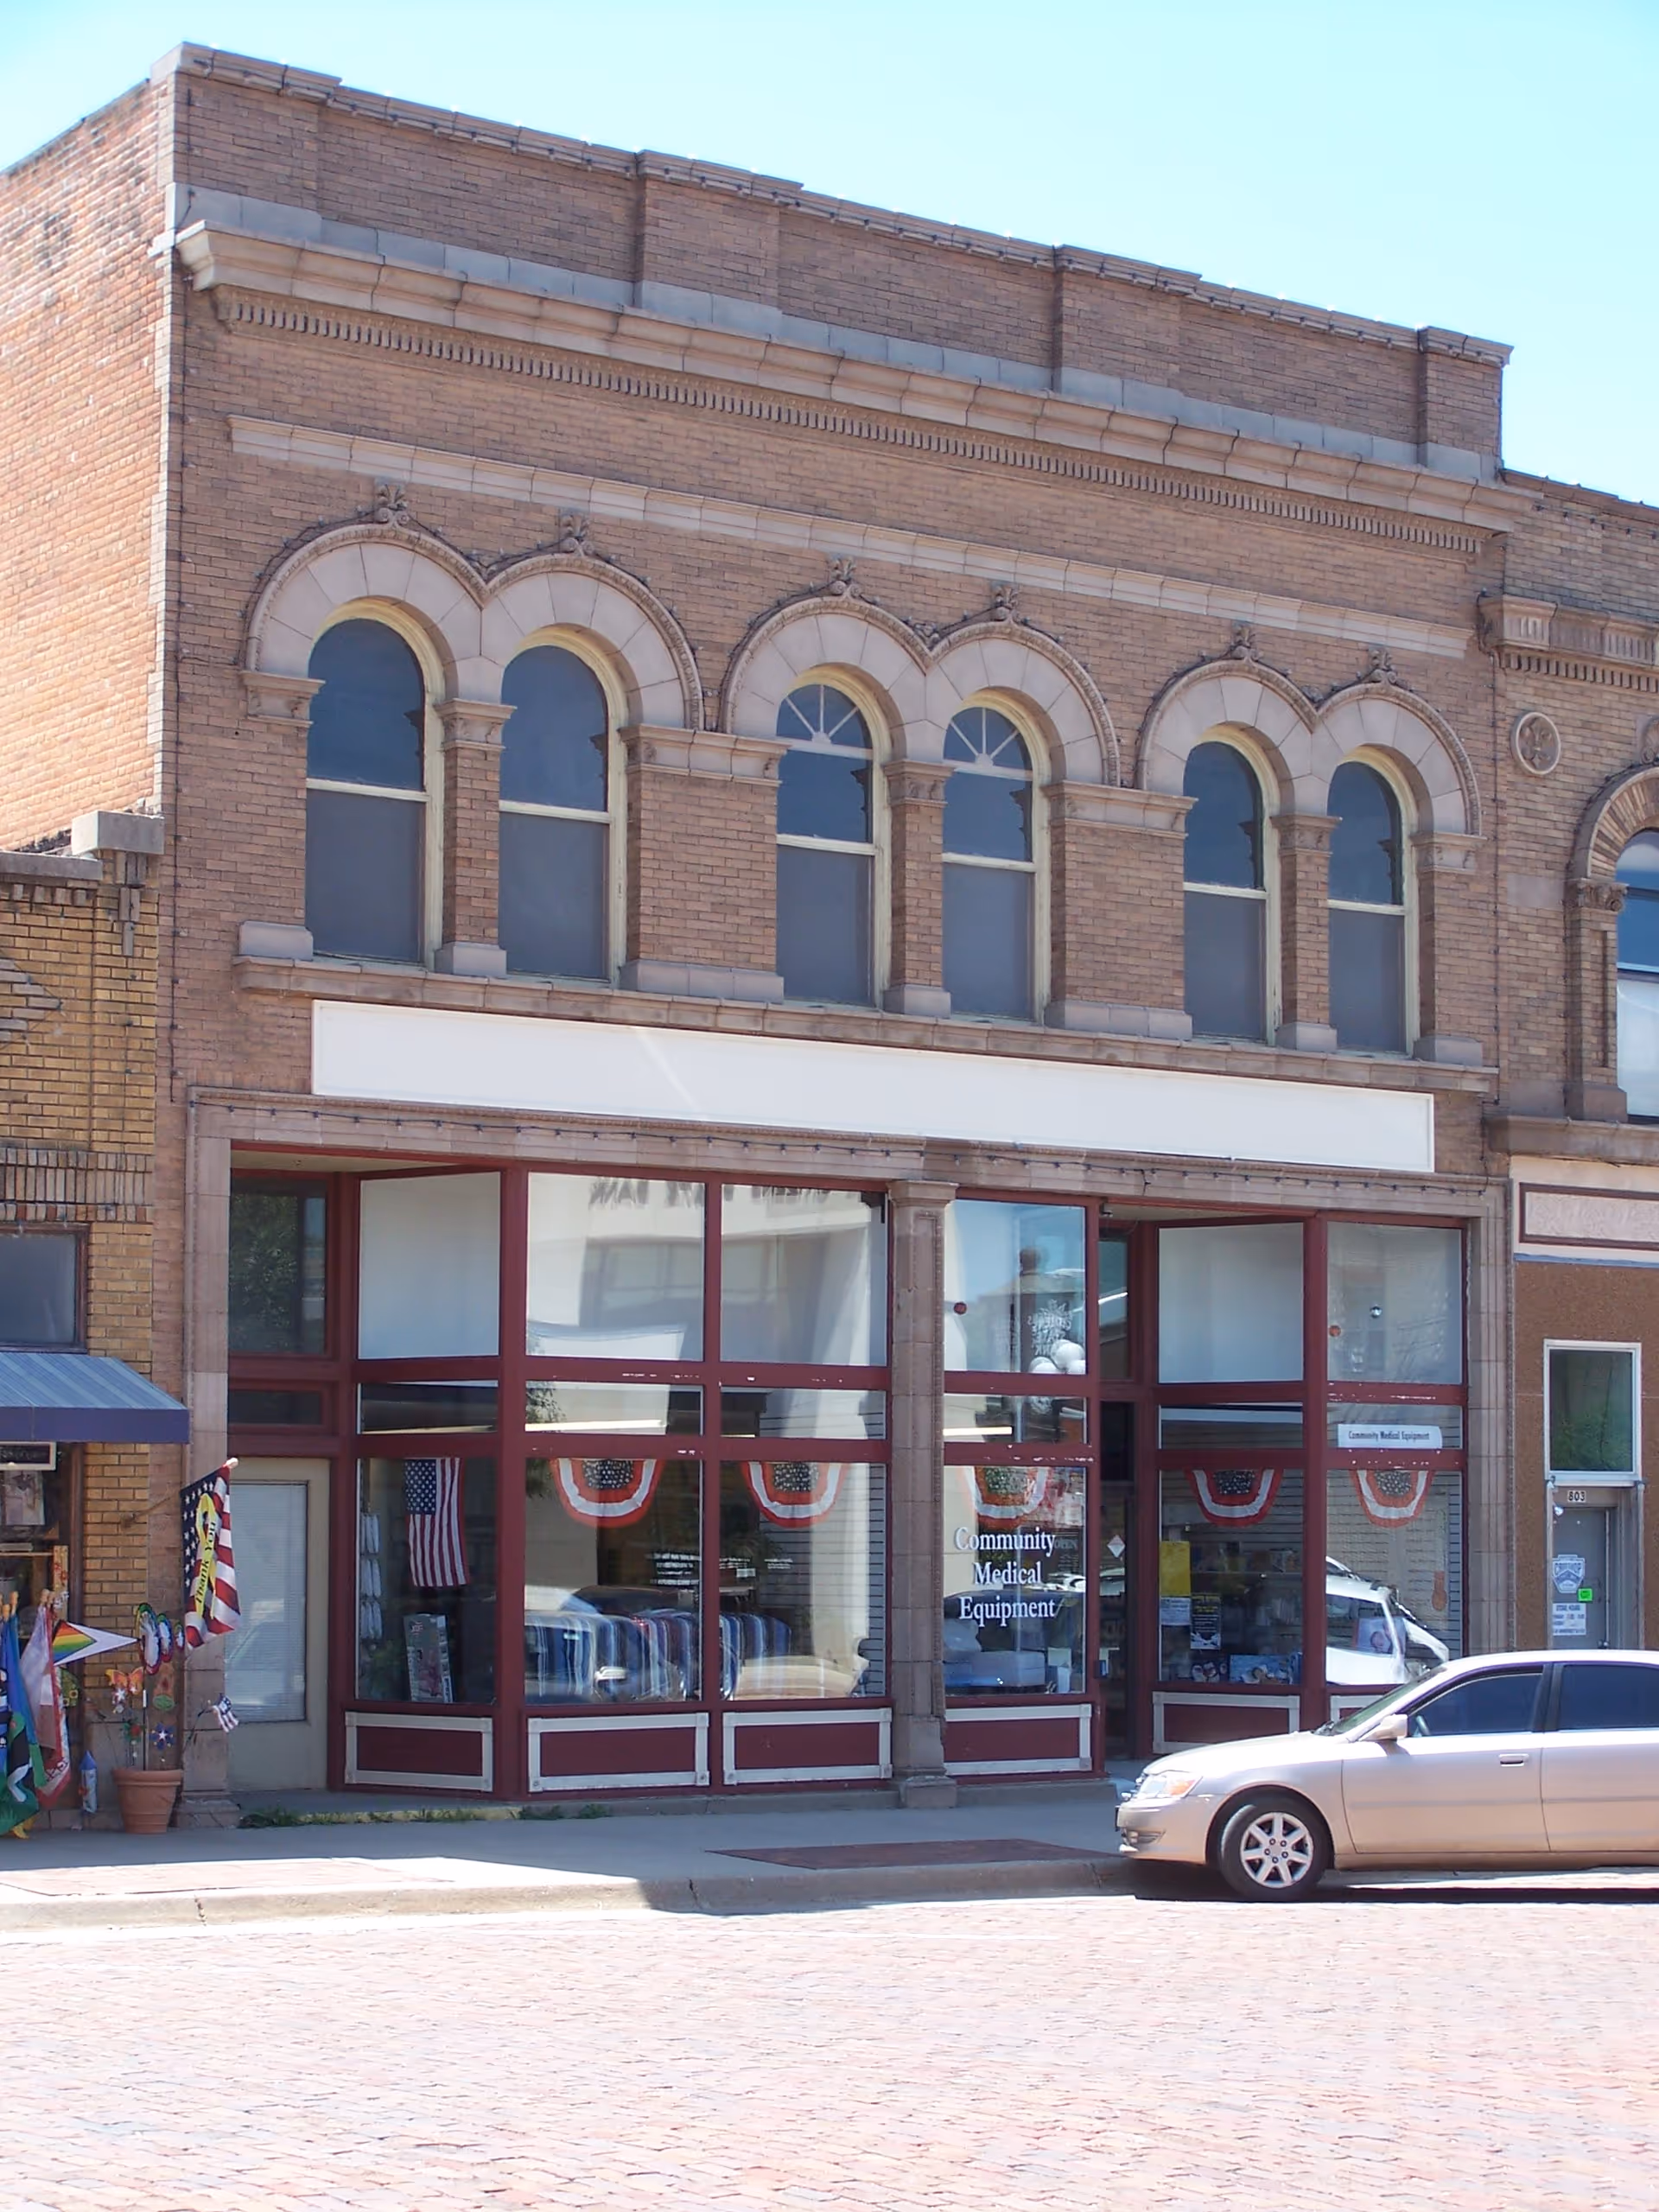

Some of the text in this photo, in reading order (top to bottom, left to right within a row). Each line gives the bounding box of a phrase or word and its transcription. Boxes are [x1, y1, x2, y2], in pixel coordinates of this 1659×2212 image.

[1348, 1431, 1430, 1442] Community Medical Equipment
[1568, 1491, 1585, 1501] 803
[956, 1527, 1055, 1557] Community
[195, 1522, 216, 1604] Thank You
[974, 1561, 1042, 1585] Medical
[959, 1596, 1056, 1627] Equipment
